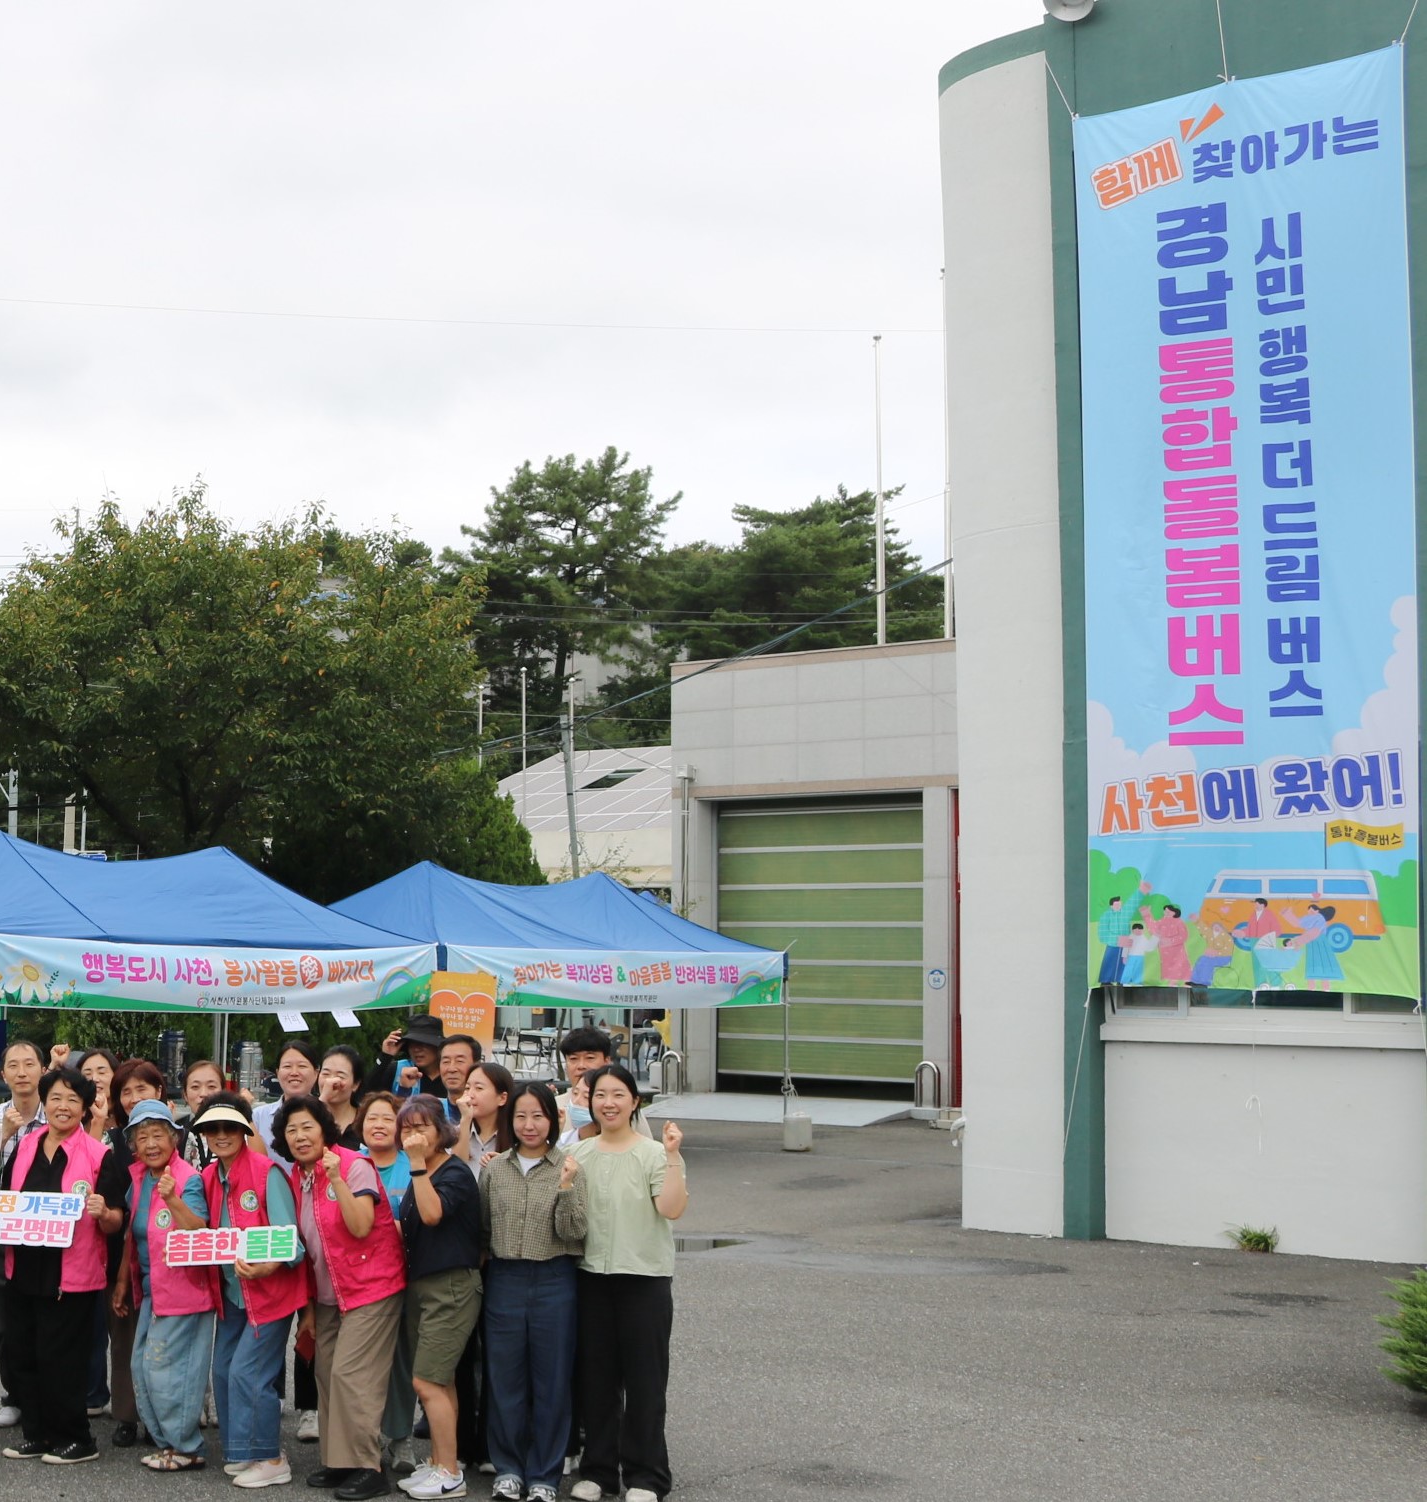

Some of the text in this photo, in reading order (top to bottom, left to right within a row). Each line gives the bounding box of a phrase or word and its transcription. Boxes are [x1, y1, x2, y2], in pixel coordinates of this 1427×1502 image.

[1093, 116, 1379, 207] 함께 찾아가는
[1255, 212, 1305, 316] 시민
[1259, 325, 1311, 425] 행복
[1157, 202, 1244, 746] 경남통합돌봄버스
[1267, 616, 1324, 717] 버스
[1100, 751, 1404, 834] 사천에 왔어!
[82, 952, 167, 984] 행복도시
[174, 953, 219, 987] 사천,
[328, 960, 375, 984] 빠지다
[513, 959, 739, 987] 찾아가는 복지상담 & 마음돌봄 반려식물 체험
[0, 1217, 71, 1244] 곤명면
[24, 1194, 81, 1216] 가득한
[169, 1228, 295, 1263] 촘촘한 돌봄
